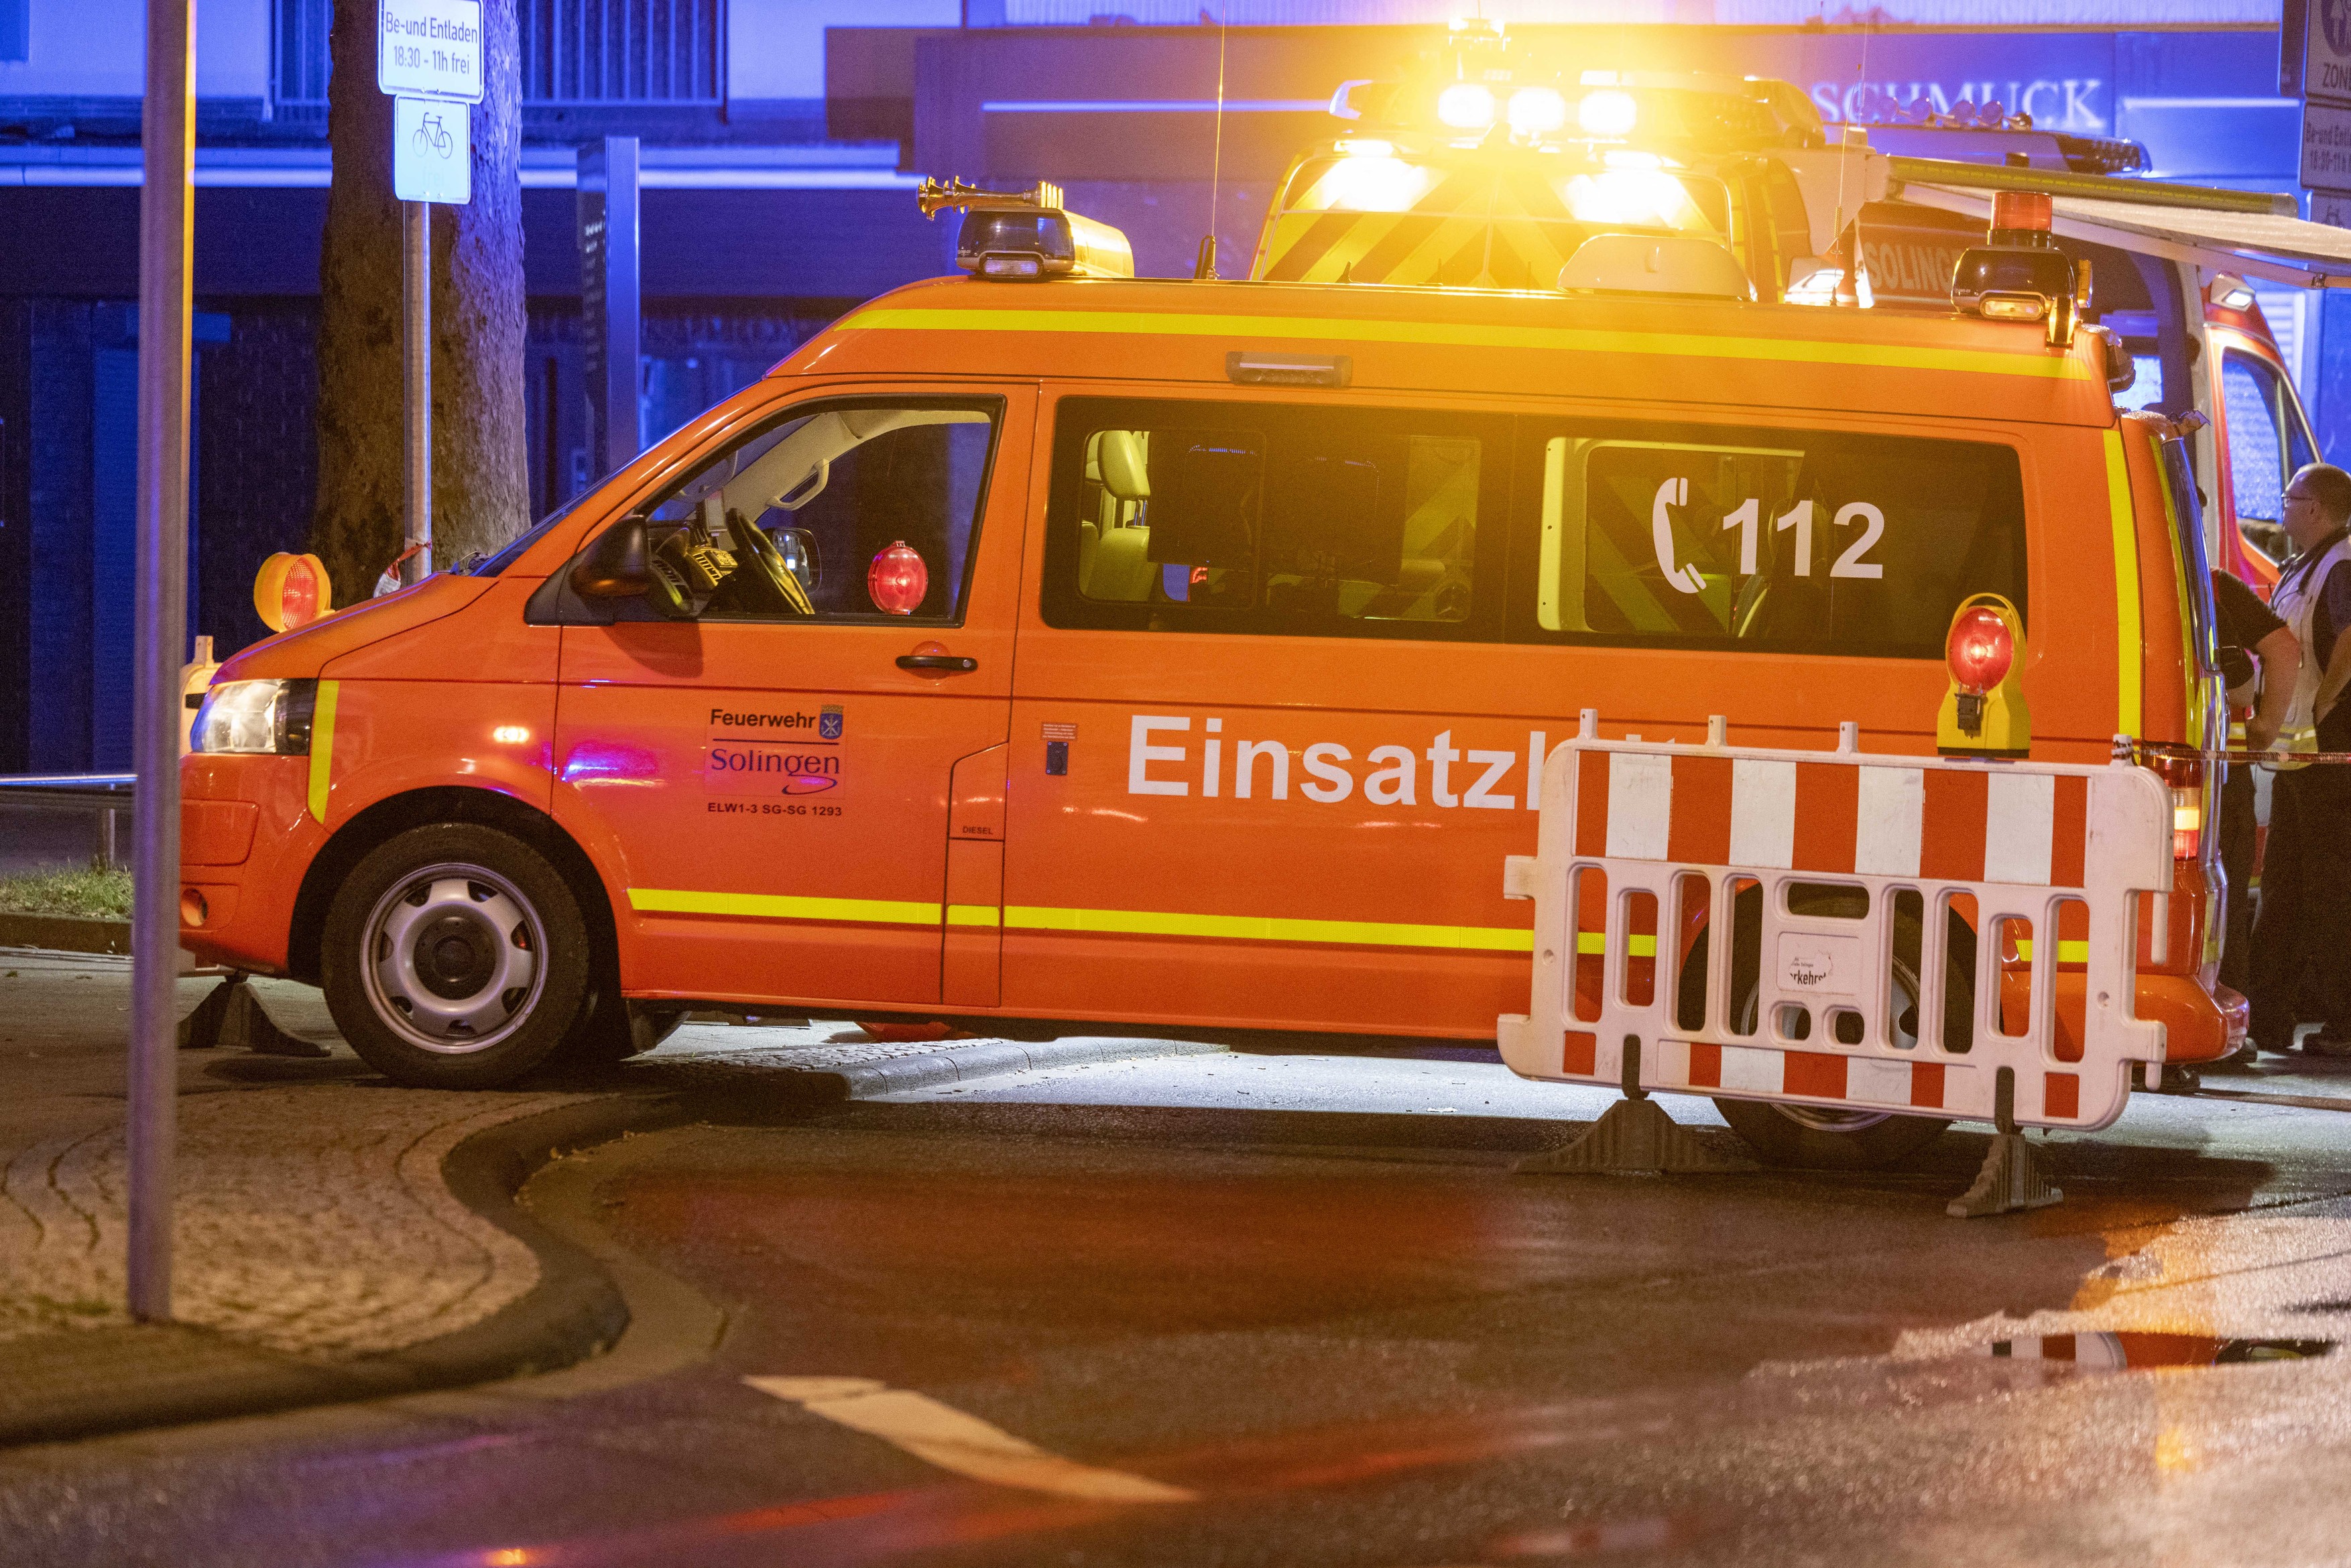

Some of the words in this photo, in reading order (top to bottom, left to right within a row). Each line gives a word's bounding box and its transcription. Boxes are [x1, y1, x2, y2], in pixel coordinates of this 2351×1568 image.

[385, 11, 427, 37] Be-und
[430, 17, 478, 44] Entladen
[394, 46, 420, 68] 18:30
[432, 50, 448, 72] 11h
[452, 52, 469, 74] frei
[1864, 242, 1962, 292] SOLING
[1723, 498, 1884, 579] 112
[711, 709, 815, 729] Feuerwehr
[711, 748, 839, 795] Solingen
[1128, 715, 1546, 811] Einsatzl
[708, 802, 758, 814] ELW1-3
[762, 804, 806, 815] SG-SG
[812, 806, 842, 817] 1293
[962, 826, 993, 835] DIESEL
